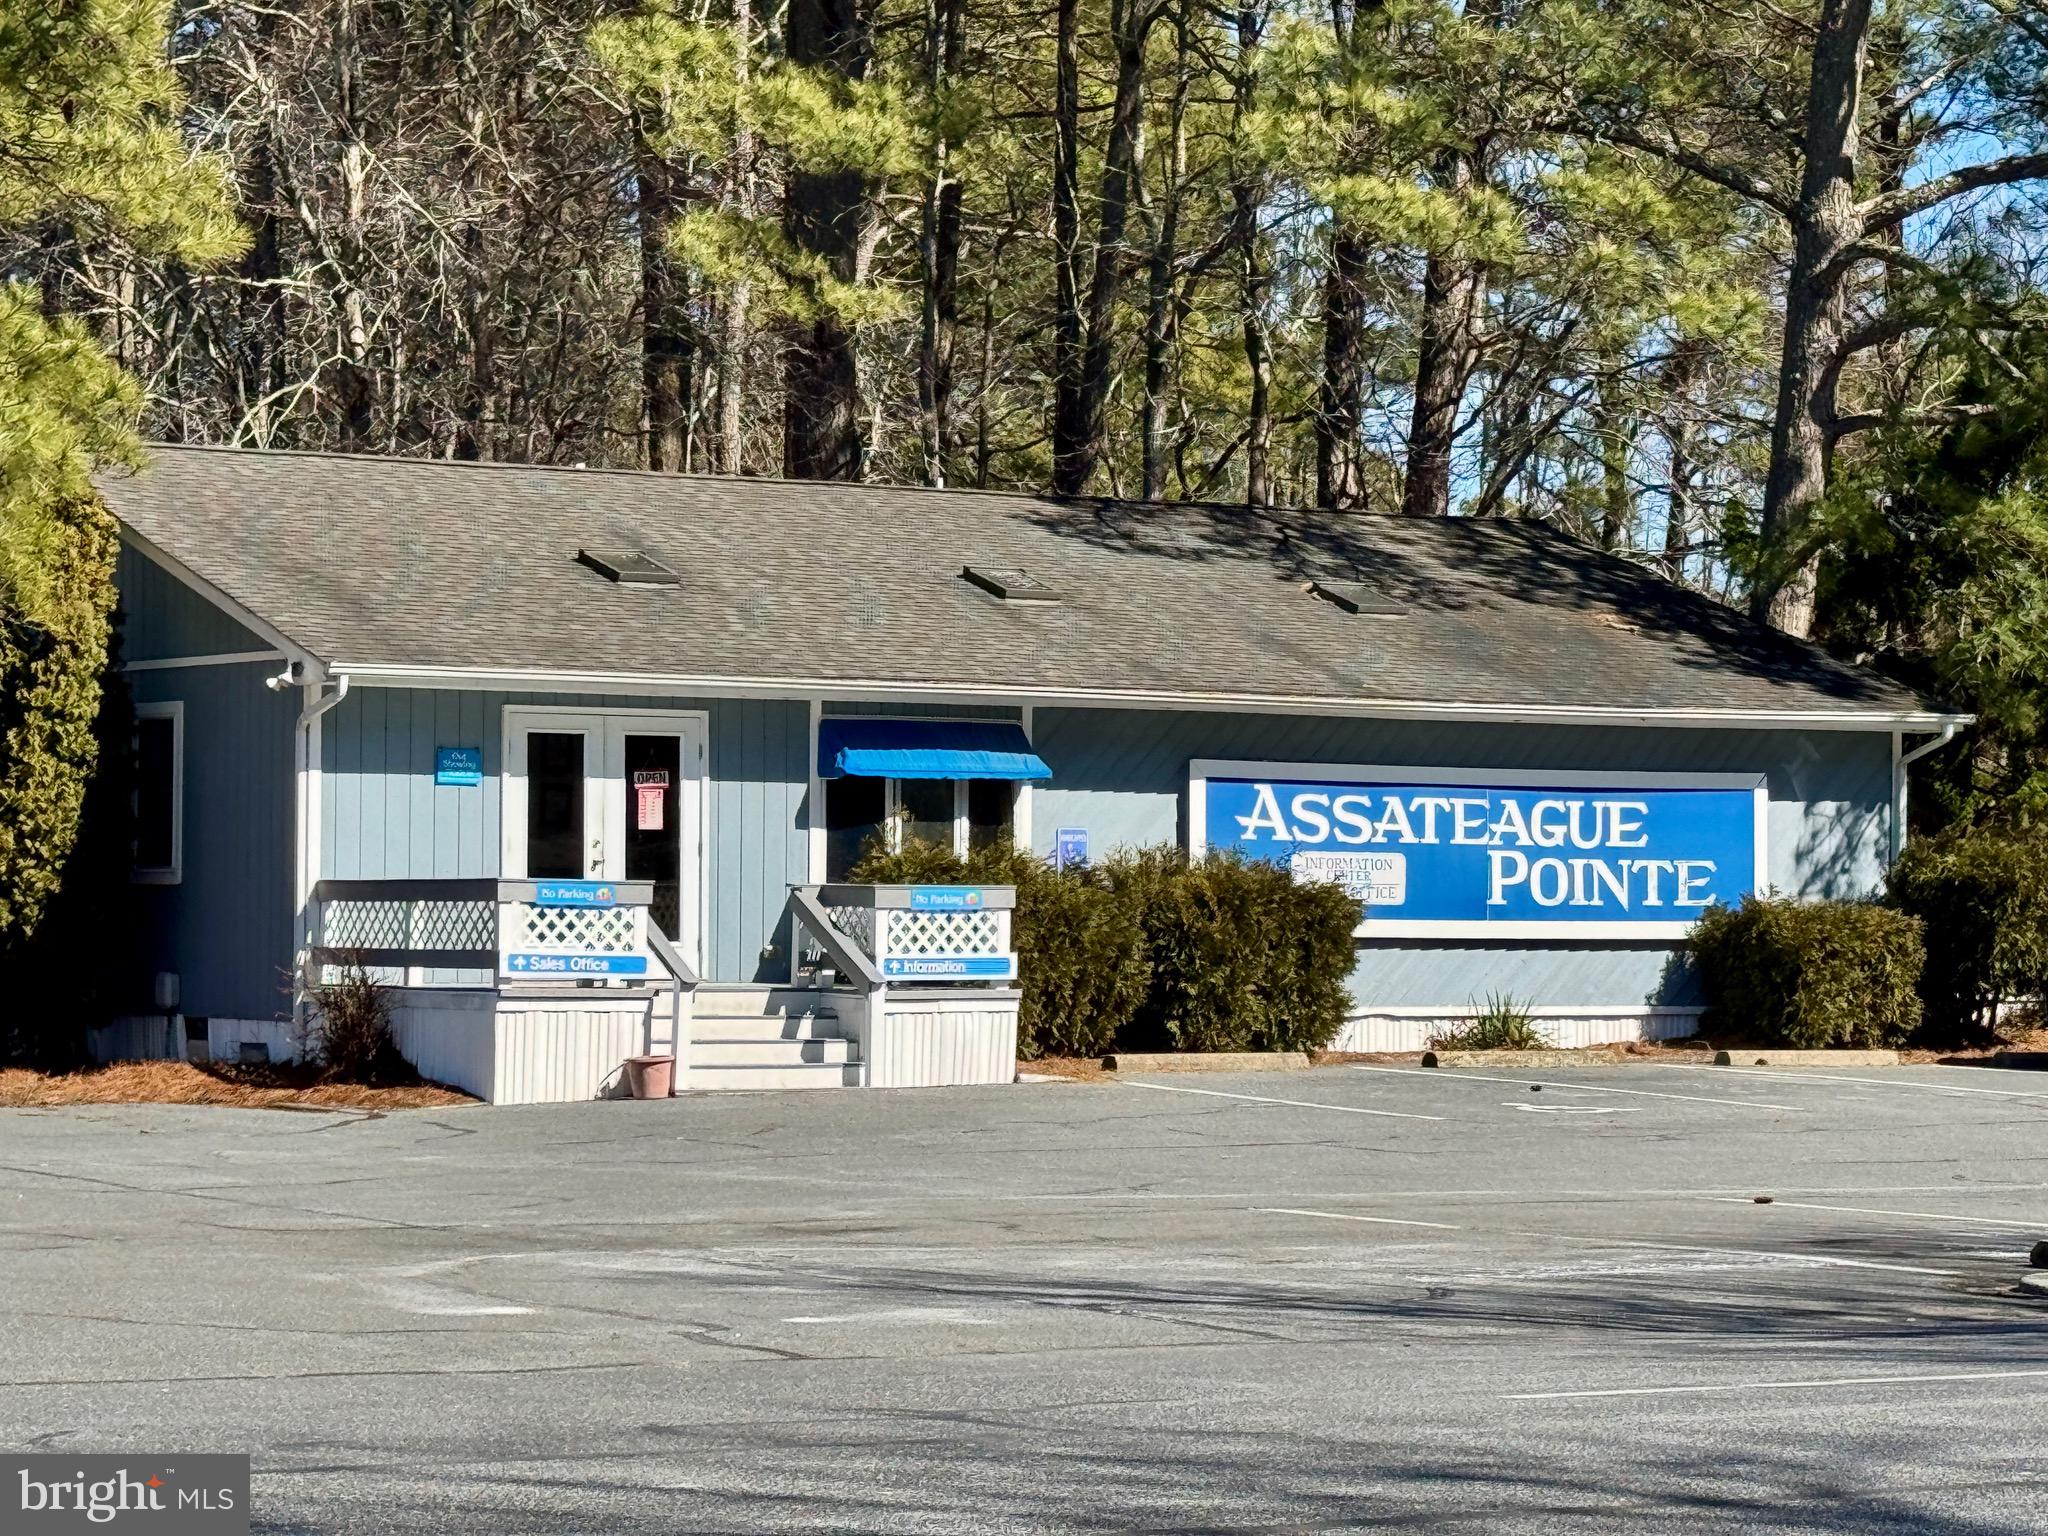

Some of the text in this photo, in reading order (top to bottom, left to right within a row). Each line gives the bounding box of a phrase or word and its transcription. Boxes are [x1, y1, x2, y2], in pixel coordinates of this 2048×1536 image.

[637, 772, 666, 784] OPEN
[1234, 783, 1650, 849] ASSATEAGUE
[1305, 857, 1393, 871] INFORMATION
[1486, 850, 1718, 913] POINTE
[541, 888, 594, 901] No Parking
[915, 893, 964, 906] No Parking
[529, 956, 610, 971] Sales Office
[903, 960, 966, 973] Information
